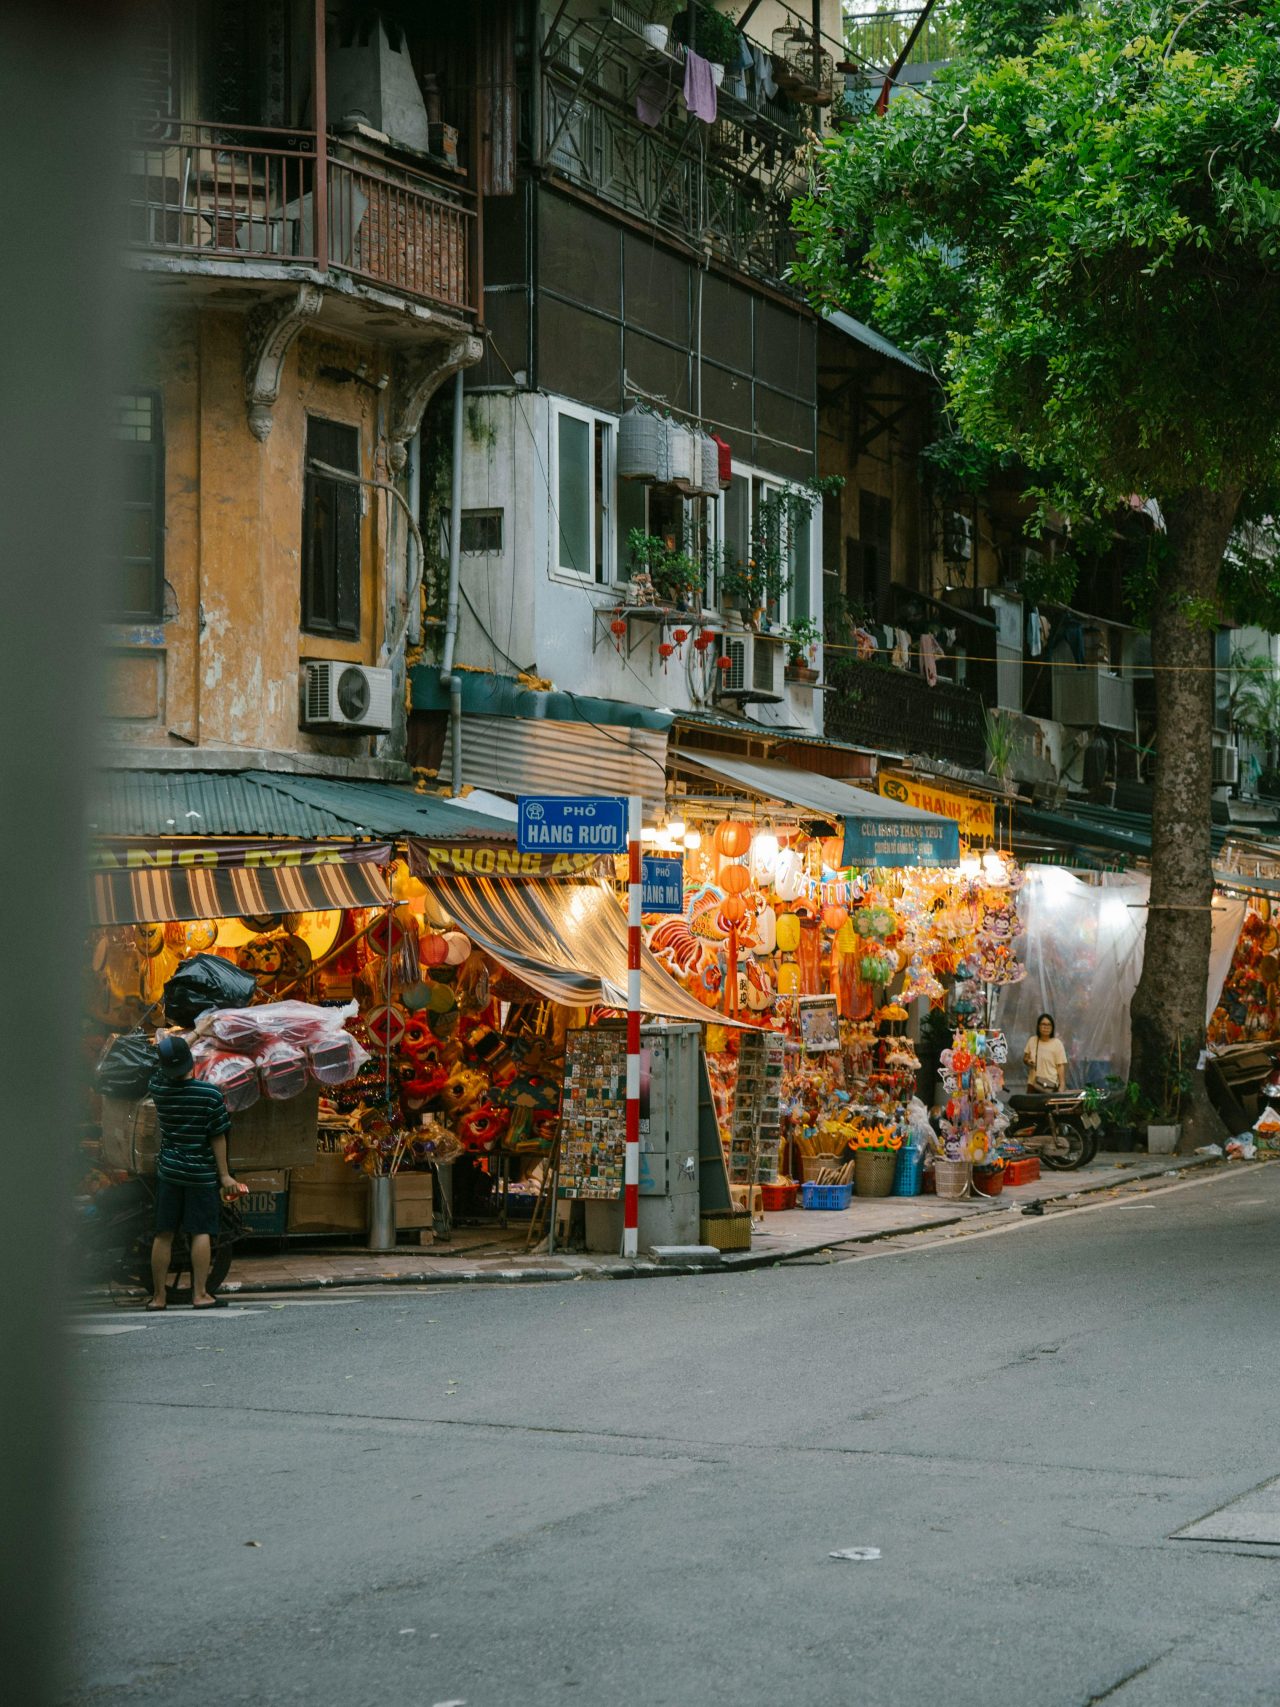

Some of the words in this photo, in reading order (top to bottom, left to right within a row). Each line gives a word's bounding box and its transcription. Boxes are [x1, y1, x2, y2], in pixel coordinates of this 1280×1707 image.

[563, 802, 597, 817] PHỐ
[886, 782, 906, 799] 54
[911, 791, 961, 820] THANH
[528, 819, 573, 844] HÀNG
[428, 847, 541, 874] PHONG
[655, 864, 671, 877] PHỐ
[641, 882, 665, 905] HÀNG
[665, 882, 680, 905] MÃ
